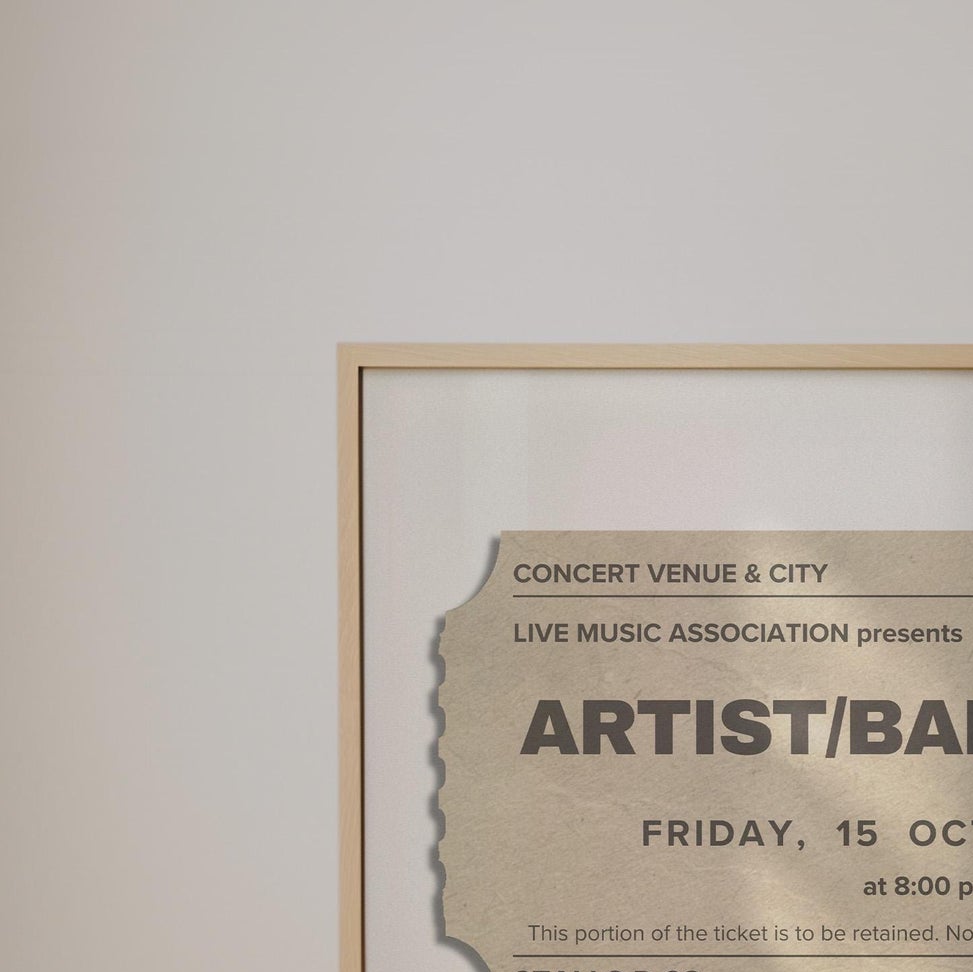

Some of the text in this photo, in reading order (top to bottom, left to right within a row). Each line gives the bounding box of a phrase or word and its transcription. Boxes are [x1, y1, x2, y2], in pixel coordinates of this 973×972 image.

[513, 563, 829, 584] CONCERT VENUE & CITY
[514, 622, 963, 648] LIVE MUSIC ASSOCIATION presents
[642, 819, 805, 852] FRIDAY,
[835, 819, 878, 847] 15
[863, 877, 888, 896] at
[894, 875, 951, 896] 8:00
[527, 924, 568, 942] This
[575, 924, 644, 946] portion
[651, 924, 672, 942] of
[675, 924, 708, 942] the
[713, 924, 768, 942] ticket
[773, 923, 789, 943] is
[794, 926, 815, 942] to
[821, 924, 846, 942] be
[853, 924, 939, 942] retained.
[946, 924, 973, 942] No
